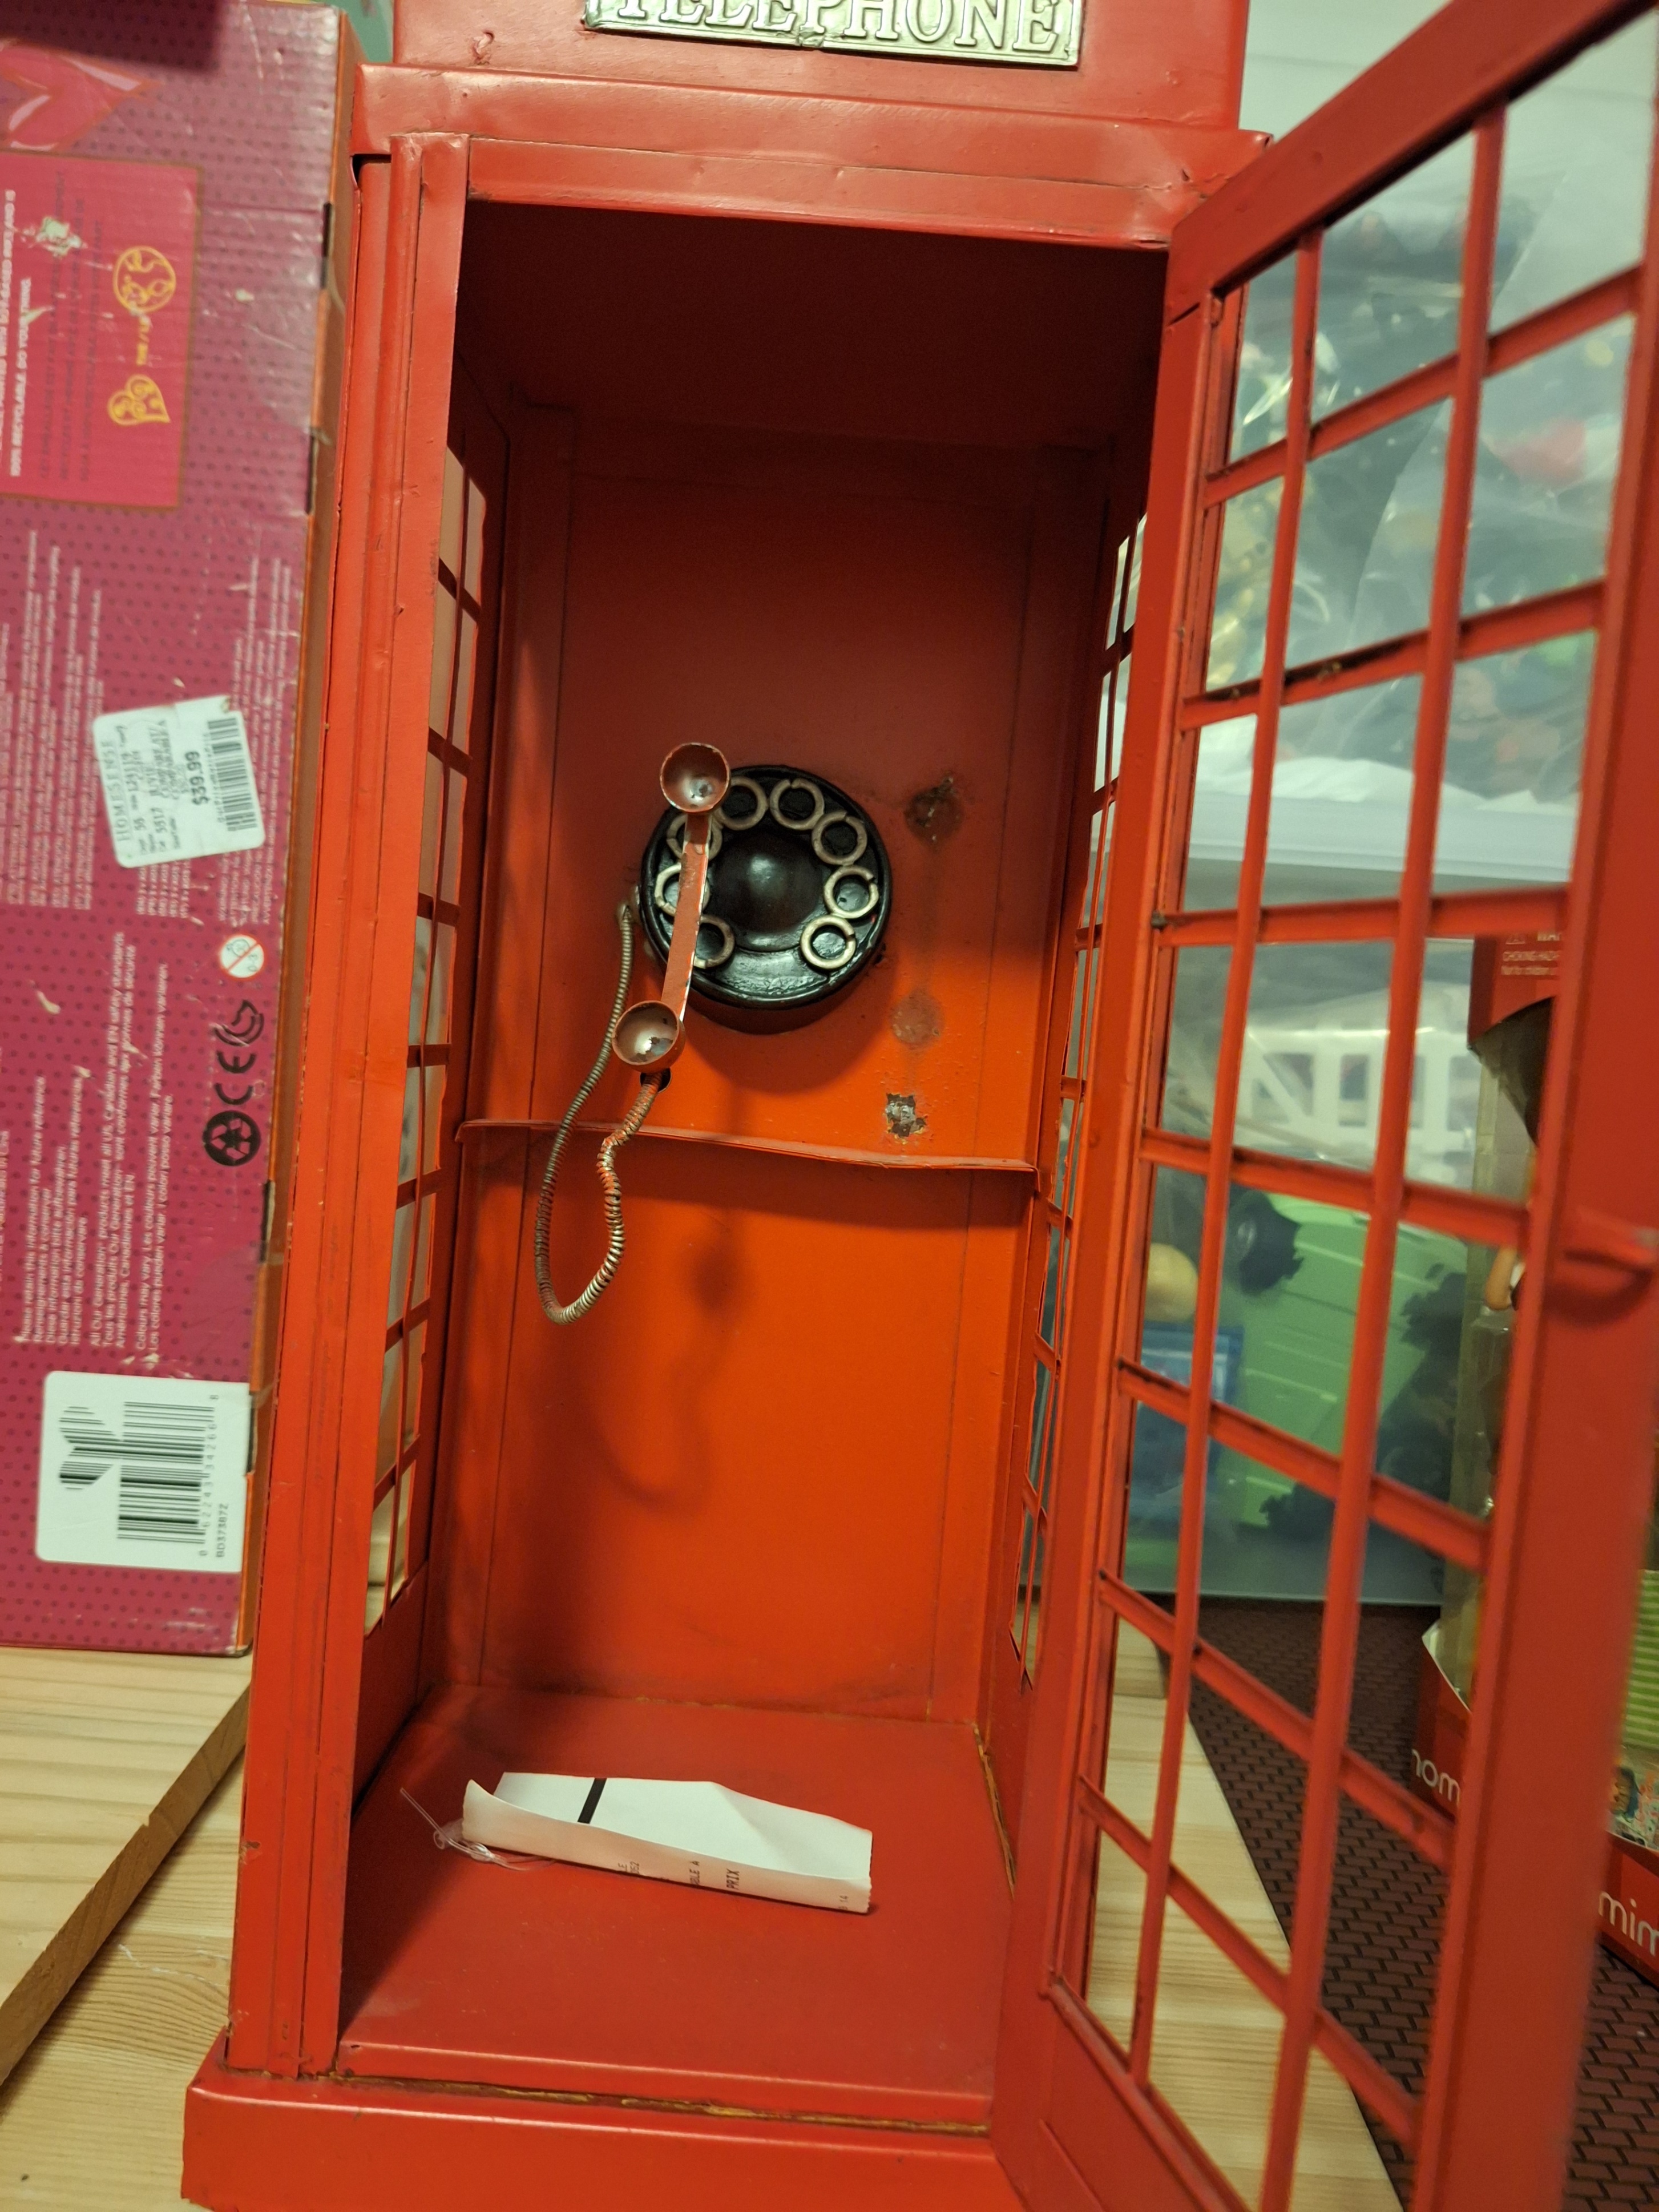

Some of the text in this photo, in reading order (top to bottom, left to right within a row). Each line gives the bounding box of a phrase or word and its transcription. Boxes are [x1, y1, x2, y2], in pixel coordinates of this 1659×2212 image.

[184, 749, 211, 806] $39.99
[106, 1044, 118, 1066] and
[30, 1131, 43, 1165] future
[100, 1143, 112, 1156] all
[29, 1168, 41, 1184] for
[99, 1159, 111, 1187] meet
[26, 1185, 40, 1248] information
[96, 1189, 110, 1238] products
[108, 1233, 120, 1254] Our
[25, 1252, 37, 1270] this
[152, 1245, 166, 1286] pueden
[23, 1273, 35, 1303] retain
[139, 1282, 151, 1306] may
[91, 1310, 103, 1329] Our
[104, 1302, 116, 1317] les
[150, 1288, 163, 1328] colores
[90, 1331, 102, 1345] All
[103, 1321, 115, 1346] Tous
[136, 1308, 150, 1349] Colours
[149, 1331, 161, 1349] Los
[726, 1868, 741, 1890] PRIX
